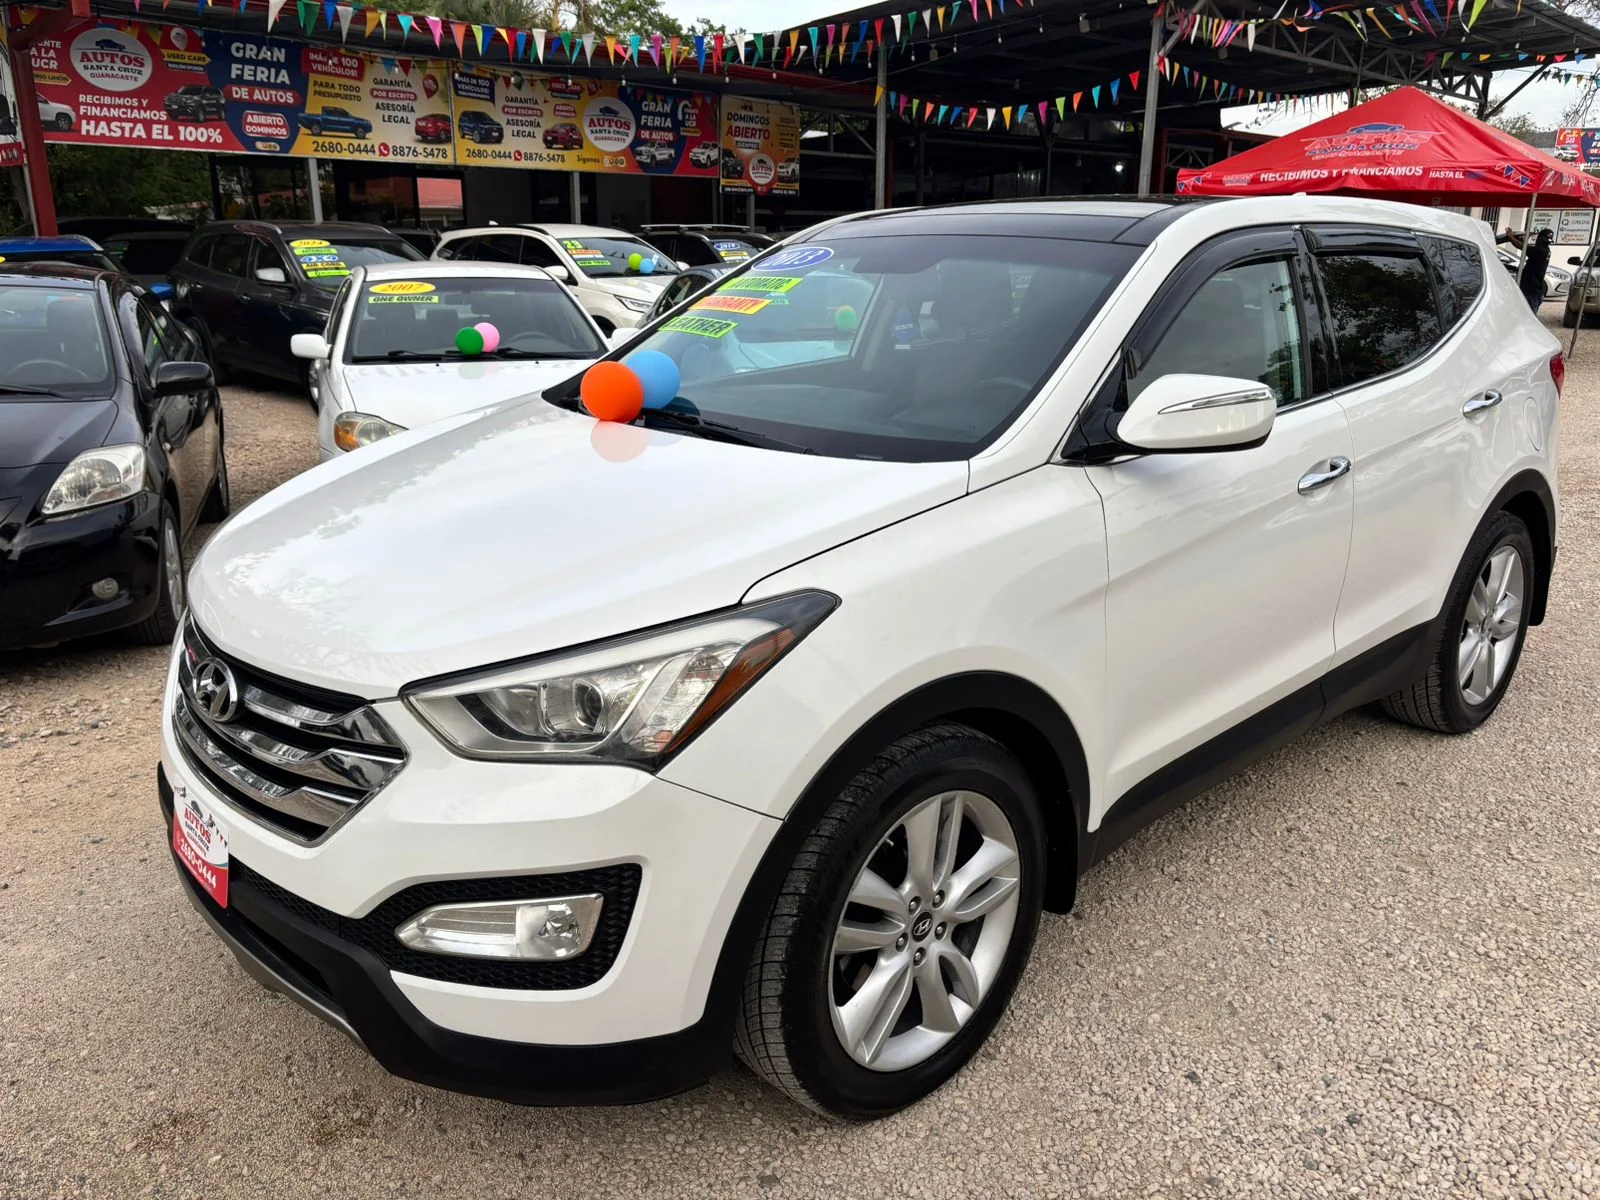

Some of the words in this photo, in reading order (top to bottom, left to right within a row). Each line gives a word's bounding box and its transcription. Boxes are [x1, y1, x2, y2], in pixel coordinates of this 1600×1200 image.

[30, 47, 38, 56] A
[42, 48, 56, 59] LA
[166, 52, 185, 60] USED
[187, 54, 207, 63] CARS
[231, 42, 286, 62] GRAN
[32, 58, 58, 70] UCR
[80, 51, 145, 68] AUTOS
[341, 58, 358, 68] 100
[82, 64, 116, 72] SANTA
[118, 66, 143, 76] CRUZ
[230, 64, 290, 84] FERIA
[312, 62, 358, 77] VEHÍCULOS!
[90, 72, 139, 82] GUANACASTE
[372, 78, 412, 88] GARANTÍA
[478, 78, 490, 86] 100
[313, 80, 336, 90] PARA
[338, 83, 360, 93] TODO
[79, 94, 138, 106] RECIBIMOS
[141, 99, 148, 107] Y
[232, 86, 249, 100] DE
[254, 89, 294, 104] AUTOS
[313, 90, 362, 102] PRESUPUESTO
[372, 89, 388, 98] POR
[388, 91, 415, 100] ESCRITO
[504, 96, 539, 106] GARANTÍA
[642, 100, 671, 113] GRAN
[80, 106, 167, 120] FINANCIAMOS
[375, 102, 416, 113] ASESORÍA
[518, 108, 542, 116] ESCRITO
[246, 114, 284, 126] ABIERTO
[382, 114, 410, 124] LEGAL
[506, 118, 541, 128] ASESORÍA
[588, 118, 631, 130] AUTOS
[641, 115, 672, 128] FERIA
[727, 112, 770, 126] DOMINGOS
[81, 120, 146, 138] HASTA
[152, 124, 174, 140] EL
[178, 126, 222, 144] 100%
[246, 124, 287, 136] DOMINGOS
[512, 130, 536, 138] LEGAL
[640, 130, 650, 139] DE
[652, 131, 674, 140] AUTOS
[726, 125, 770, 140] ABIERTO
[1304, 133, 1434, 150] AUTOS
[312, 140, 376, 155] 2680-0444
[392, 145, 448, 159] 8876-5478
[466, 148, 512, 159] 2680-0444
[524, 152, 566, 163] 8876-5478
[1332, 169, 1339, 178] Y
[1429, 170, 1454, 178] HASTA
[758, 250, 825, 267] 2013
[382, 284, 424, 292] 2007
[184, 808, 211, 844] AUTOS
[181, 838, 216, 888] 2680-0444
